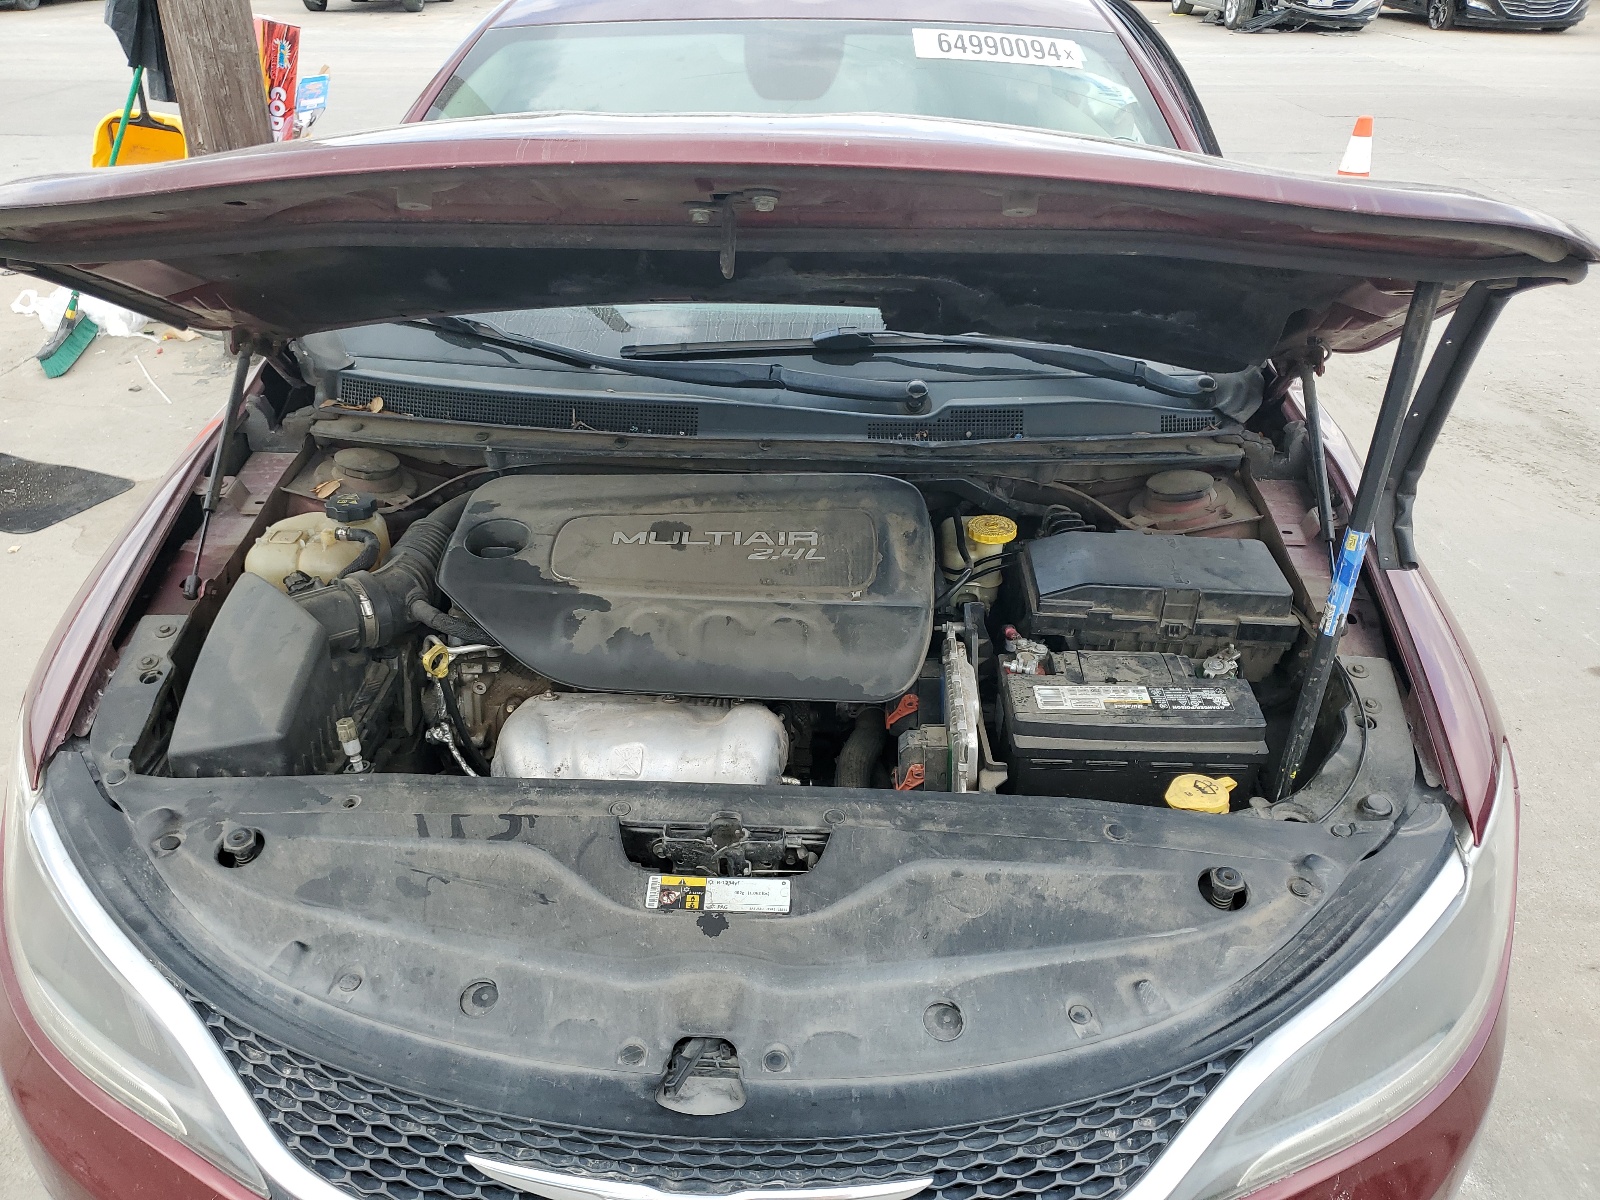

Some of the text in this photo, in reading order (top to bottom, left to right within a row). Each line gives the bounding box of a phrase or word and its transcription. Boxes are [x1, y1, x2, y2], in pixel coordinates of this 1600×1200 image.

[937, 33, 1061, 61] 64990094
[611, 531, 819, 546] MULTIAIR
[747, 548, 826, 560] 2.4L
